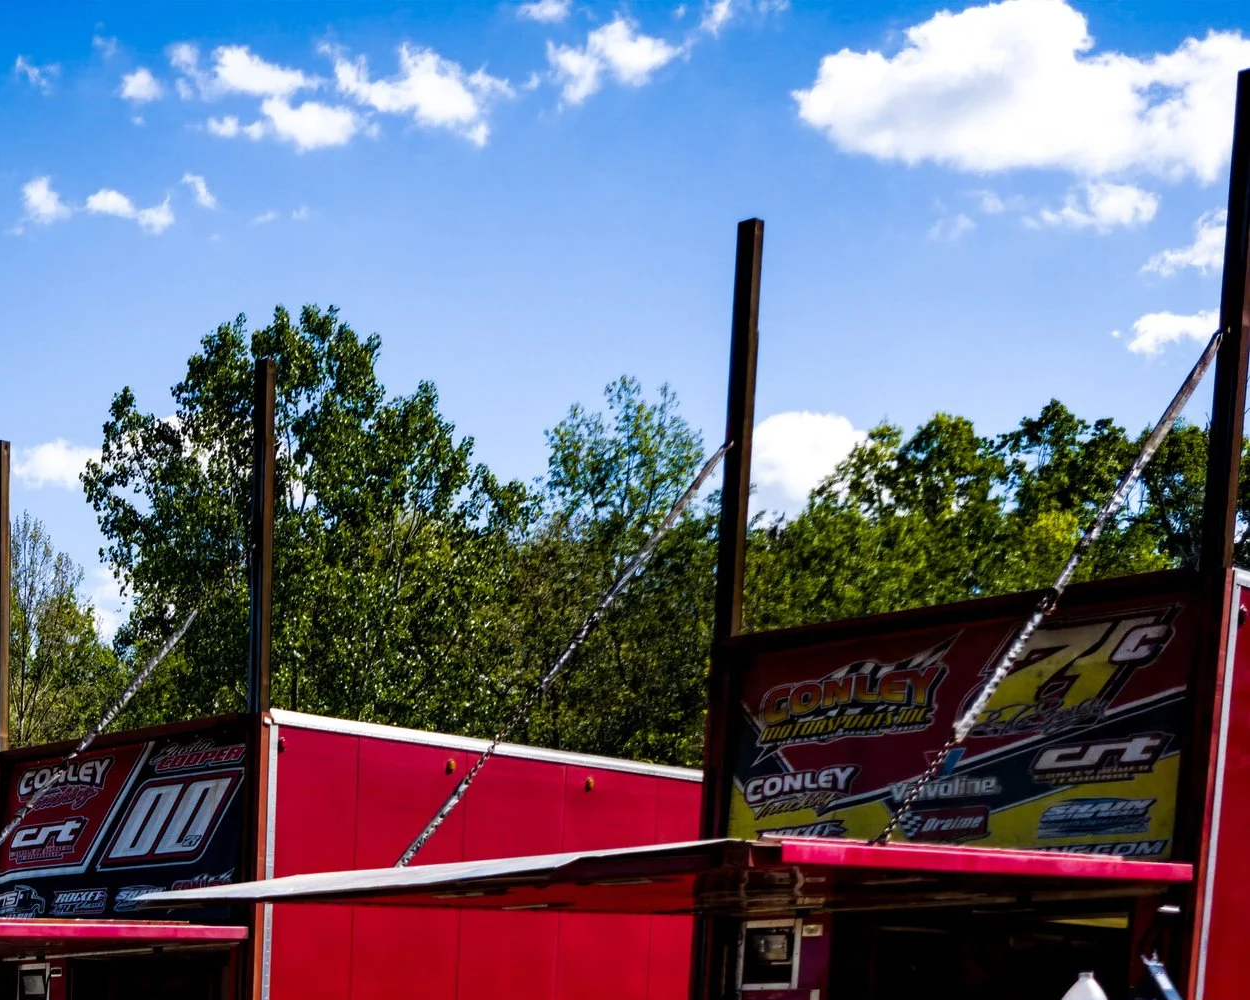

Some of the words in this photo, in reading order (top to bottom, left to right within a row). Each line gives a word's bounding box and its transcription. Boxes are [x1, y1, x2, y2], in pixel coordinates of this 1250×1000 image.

[763, 666, 940, 725] CONLEY
[760, 712, 894, 744] MOTORSPORTS
[157, 746, 246, 770] COOPER
[747, 766, 855, 801] CONLEY
[108, 776, 234, 859] 00
